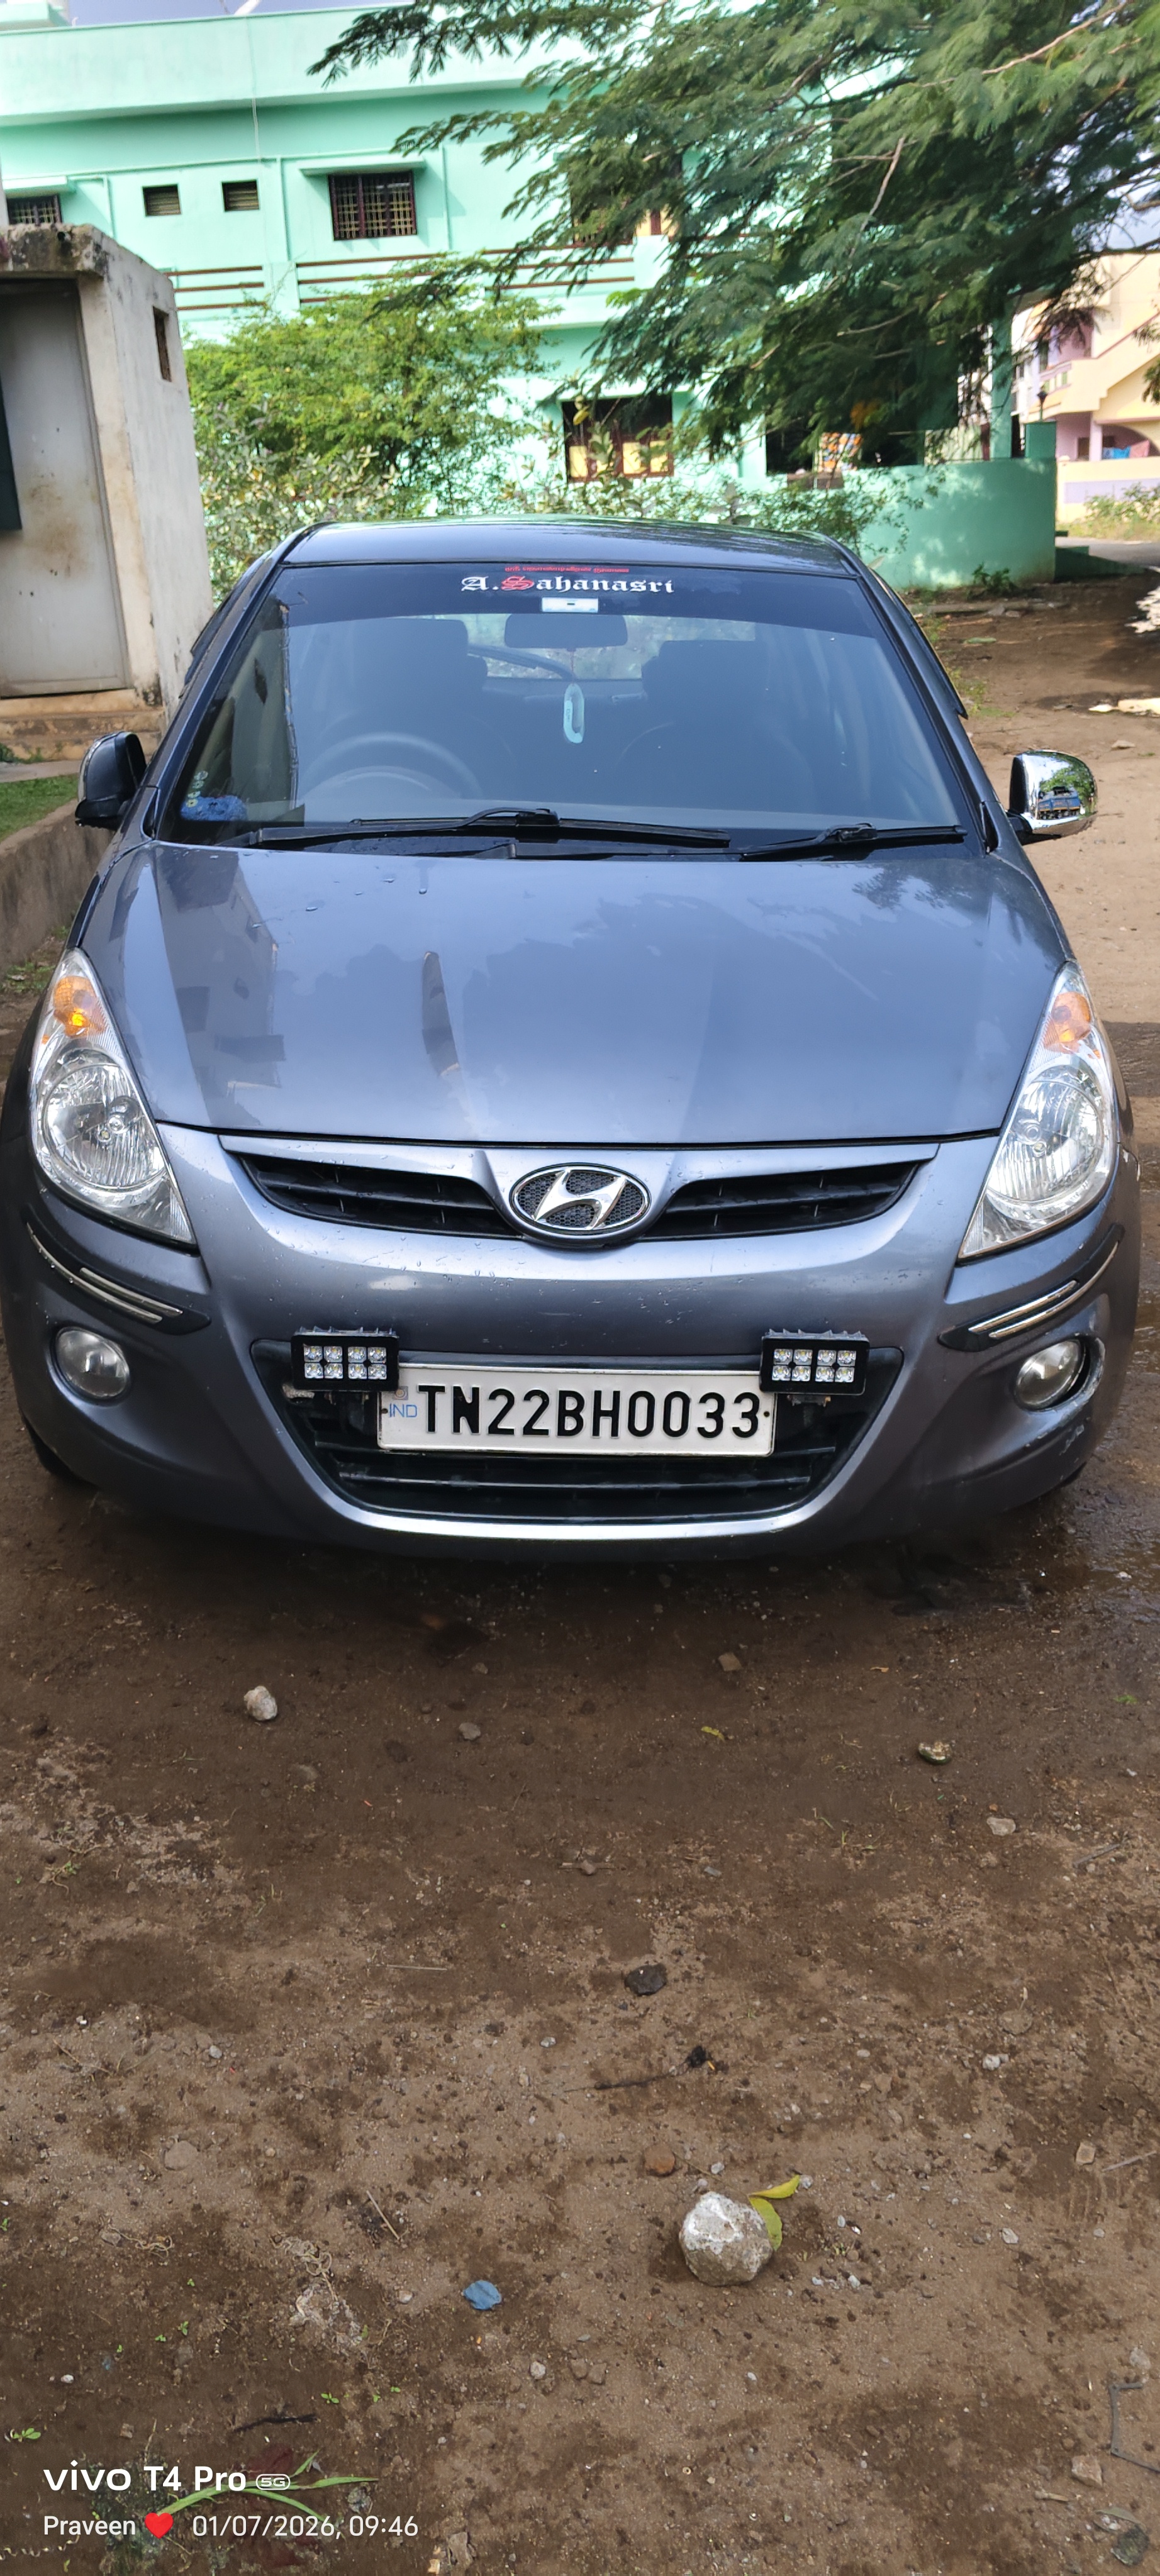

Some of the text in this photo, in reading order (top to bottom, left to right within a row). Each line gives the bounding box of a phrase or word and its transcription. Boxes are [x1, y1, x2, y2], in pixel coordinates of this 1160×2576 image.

[461, 575, 674, 594] A.Sahanasri
[389, 1403, 418, 1418] IND
[418, 1385, 761, 1438] TN22BH0033
